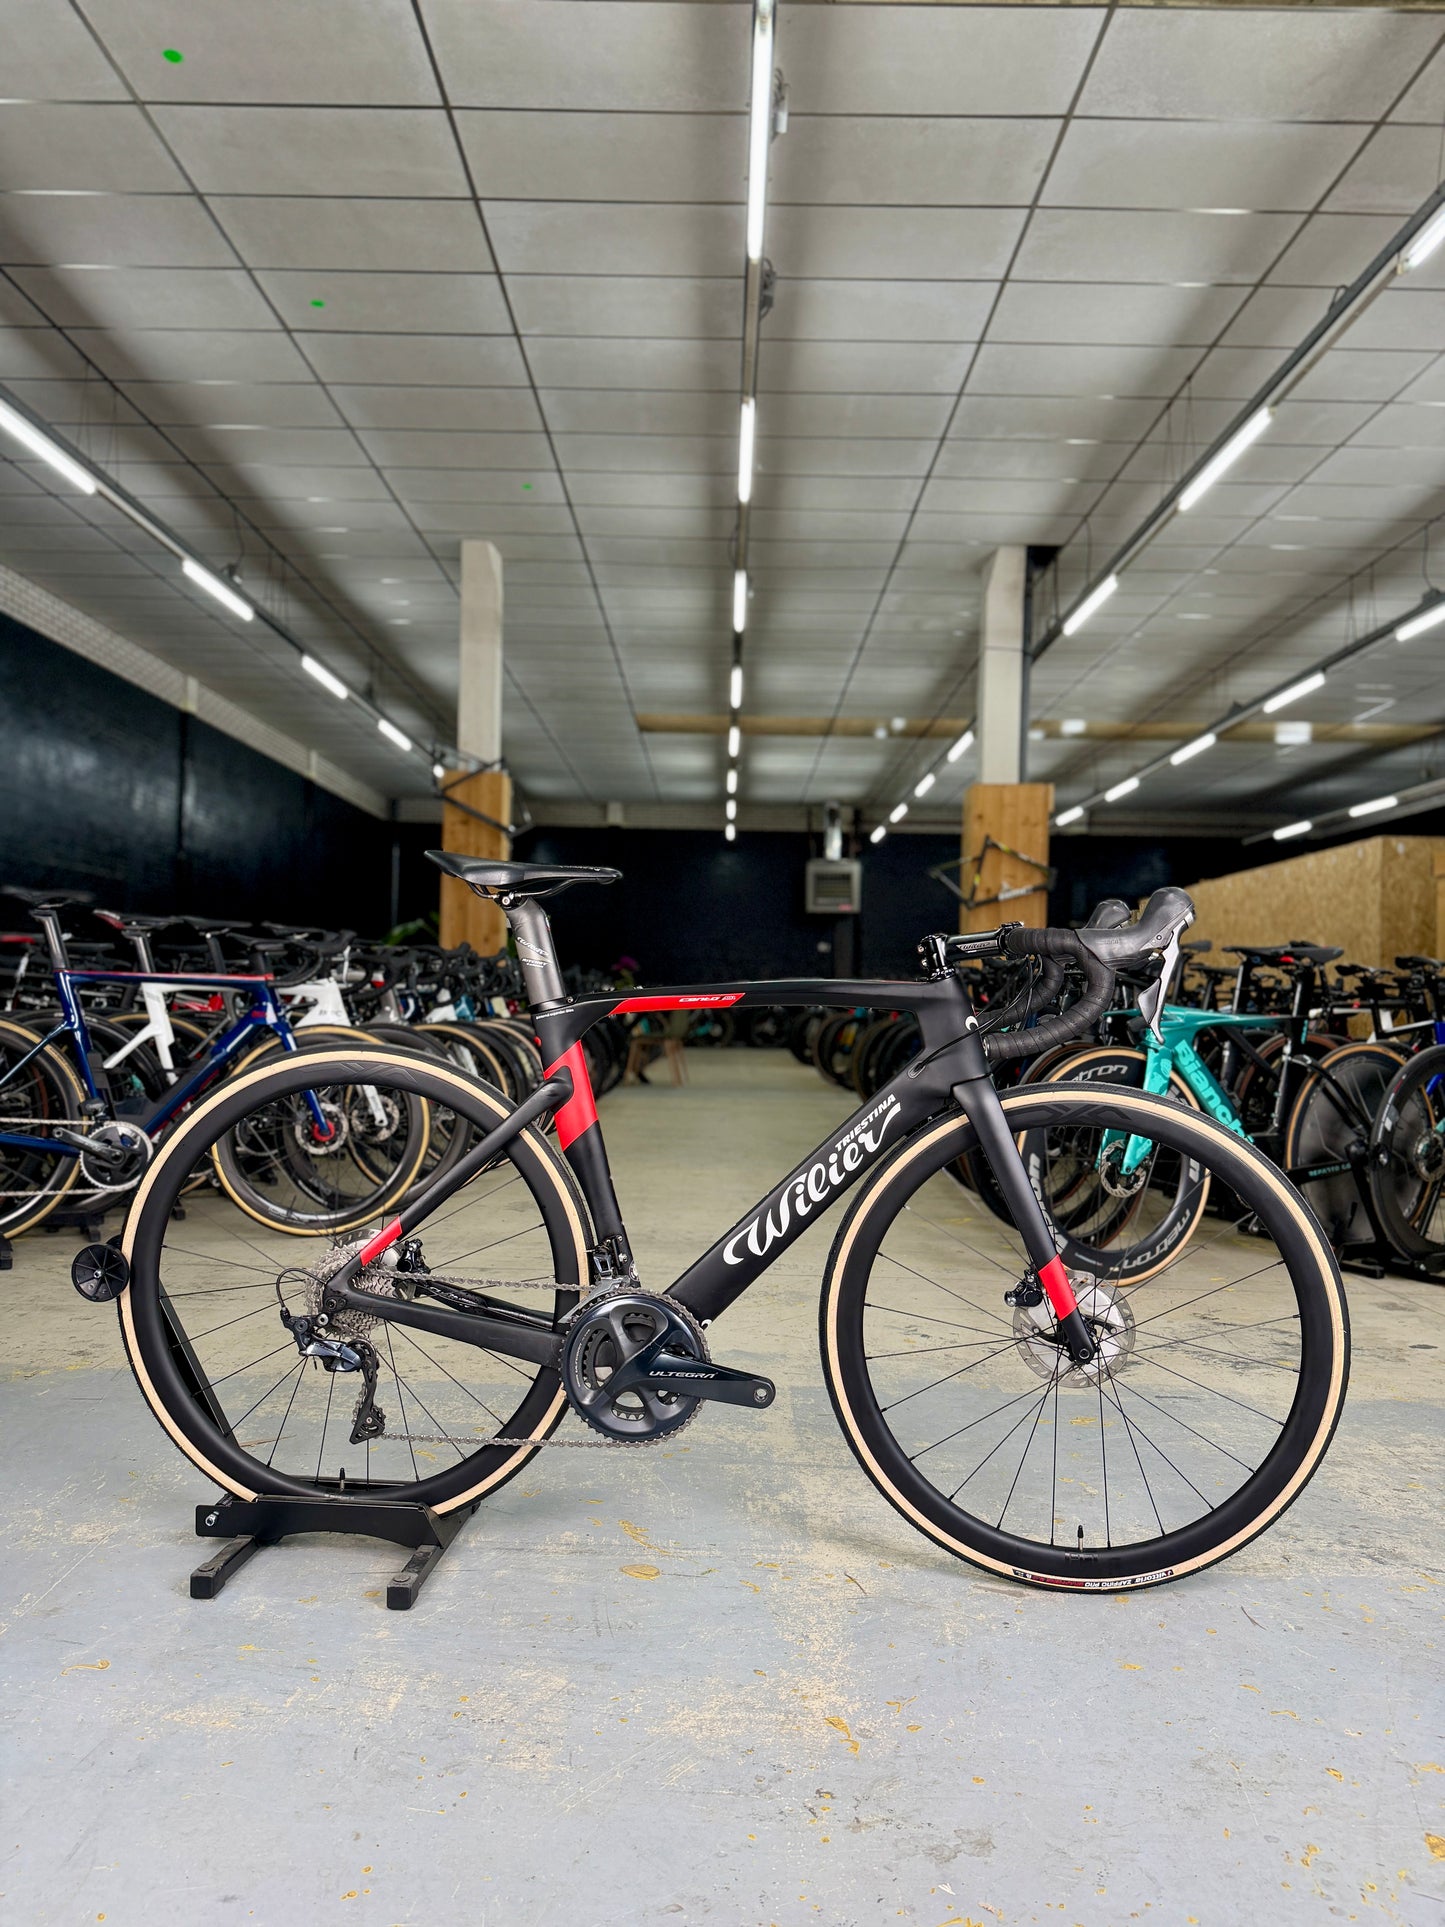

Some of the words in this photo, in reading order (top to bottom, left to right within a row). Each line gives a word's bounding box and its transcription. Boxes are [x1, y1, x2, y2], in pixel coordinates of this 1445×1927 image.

[835, 1094, 896, 1151] TRIESTINA
[1174, 1040, 1254, 1144] Bianch
[723, 1102, 901, 1265] Wilier
[1123, 1208, 1191, 1269] metron
[649, 1371, 716, 1379] ULTEGRA
